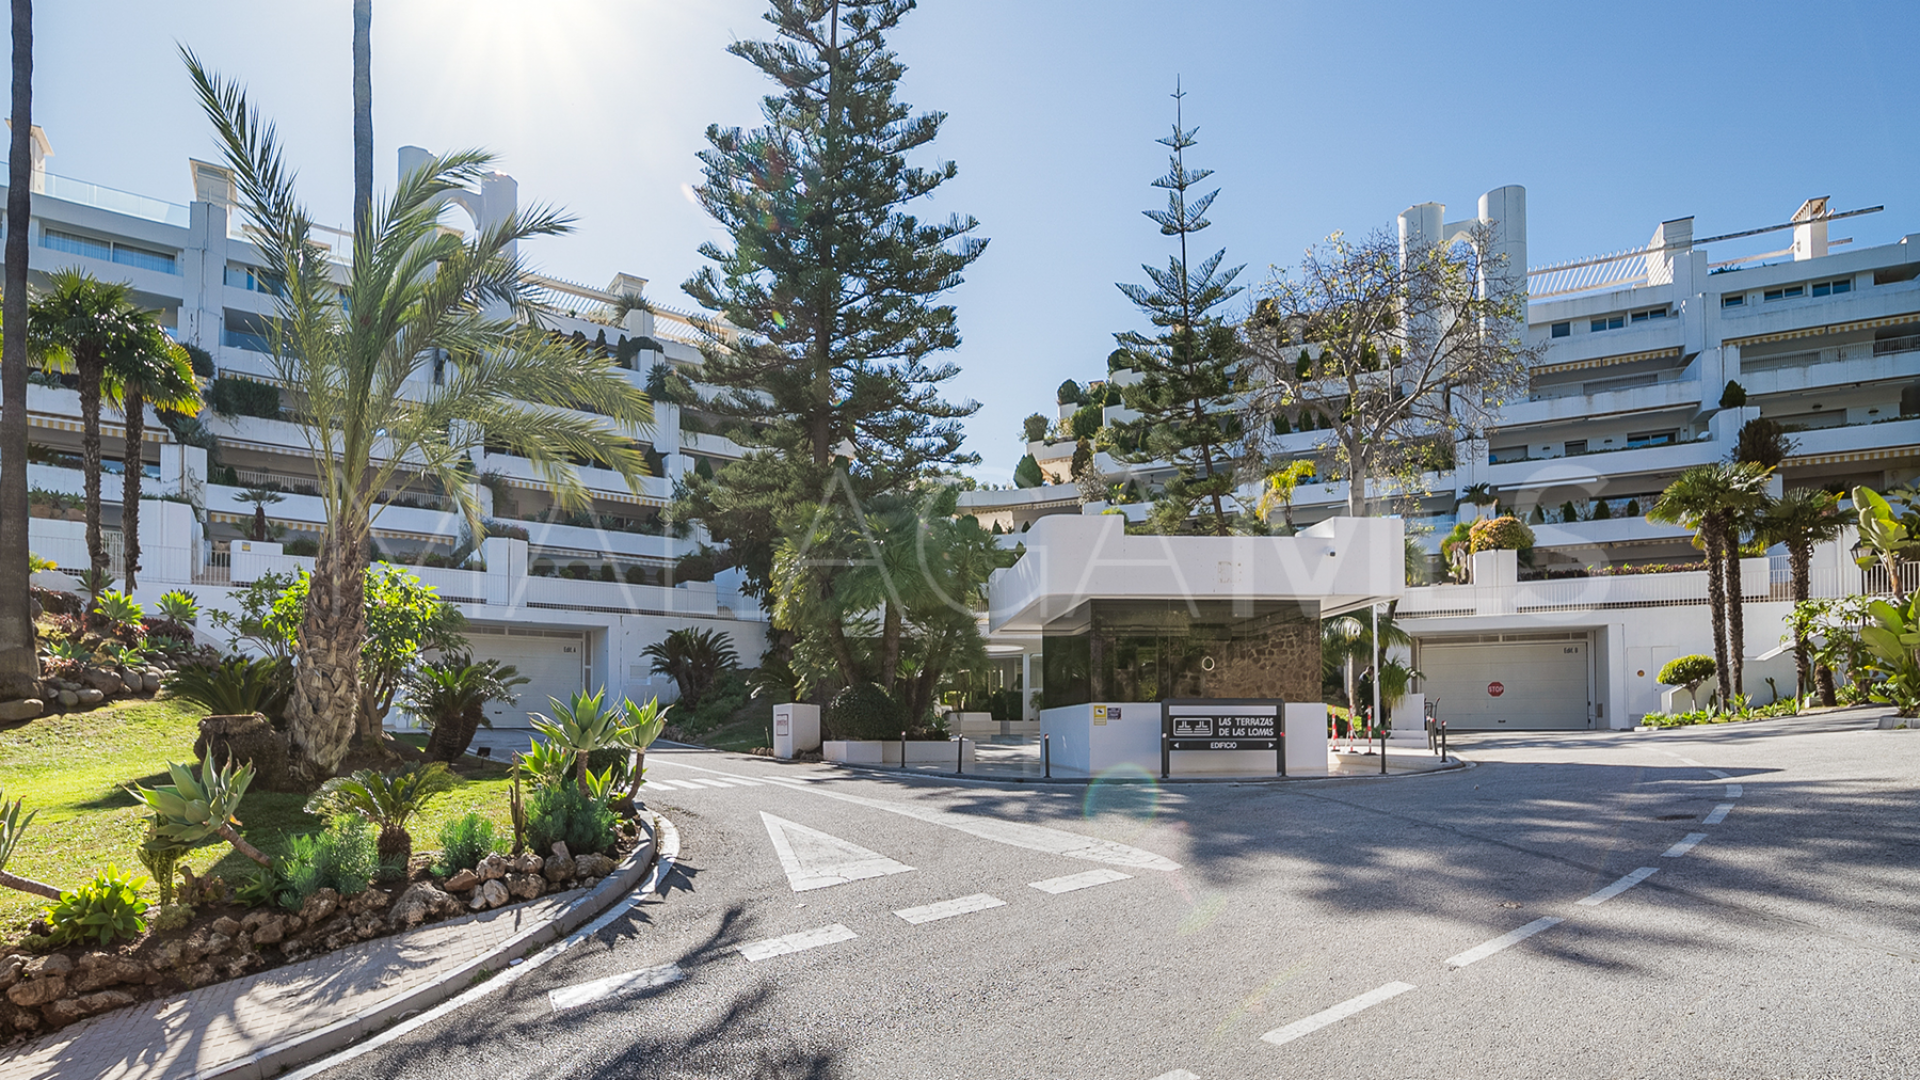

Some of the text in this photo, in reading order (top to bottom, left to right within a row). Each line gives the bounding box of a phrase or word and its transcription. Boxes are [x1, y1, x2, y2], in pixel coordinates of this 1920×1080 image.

[1488, 685, 1504, 693] STOP
[1218, 717, 1274, 726] LAS TERRAZAS
[1218, 728, 1274, 736] DE LAS LOMAS
